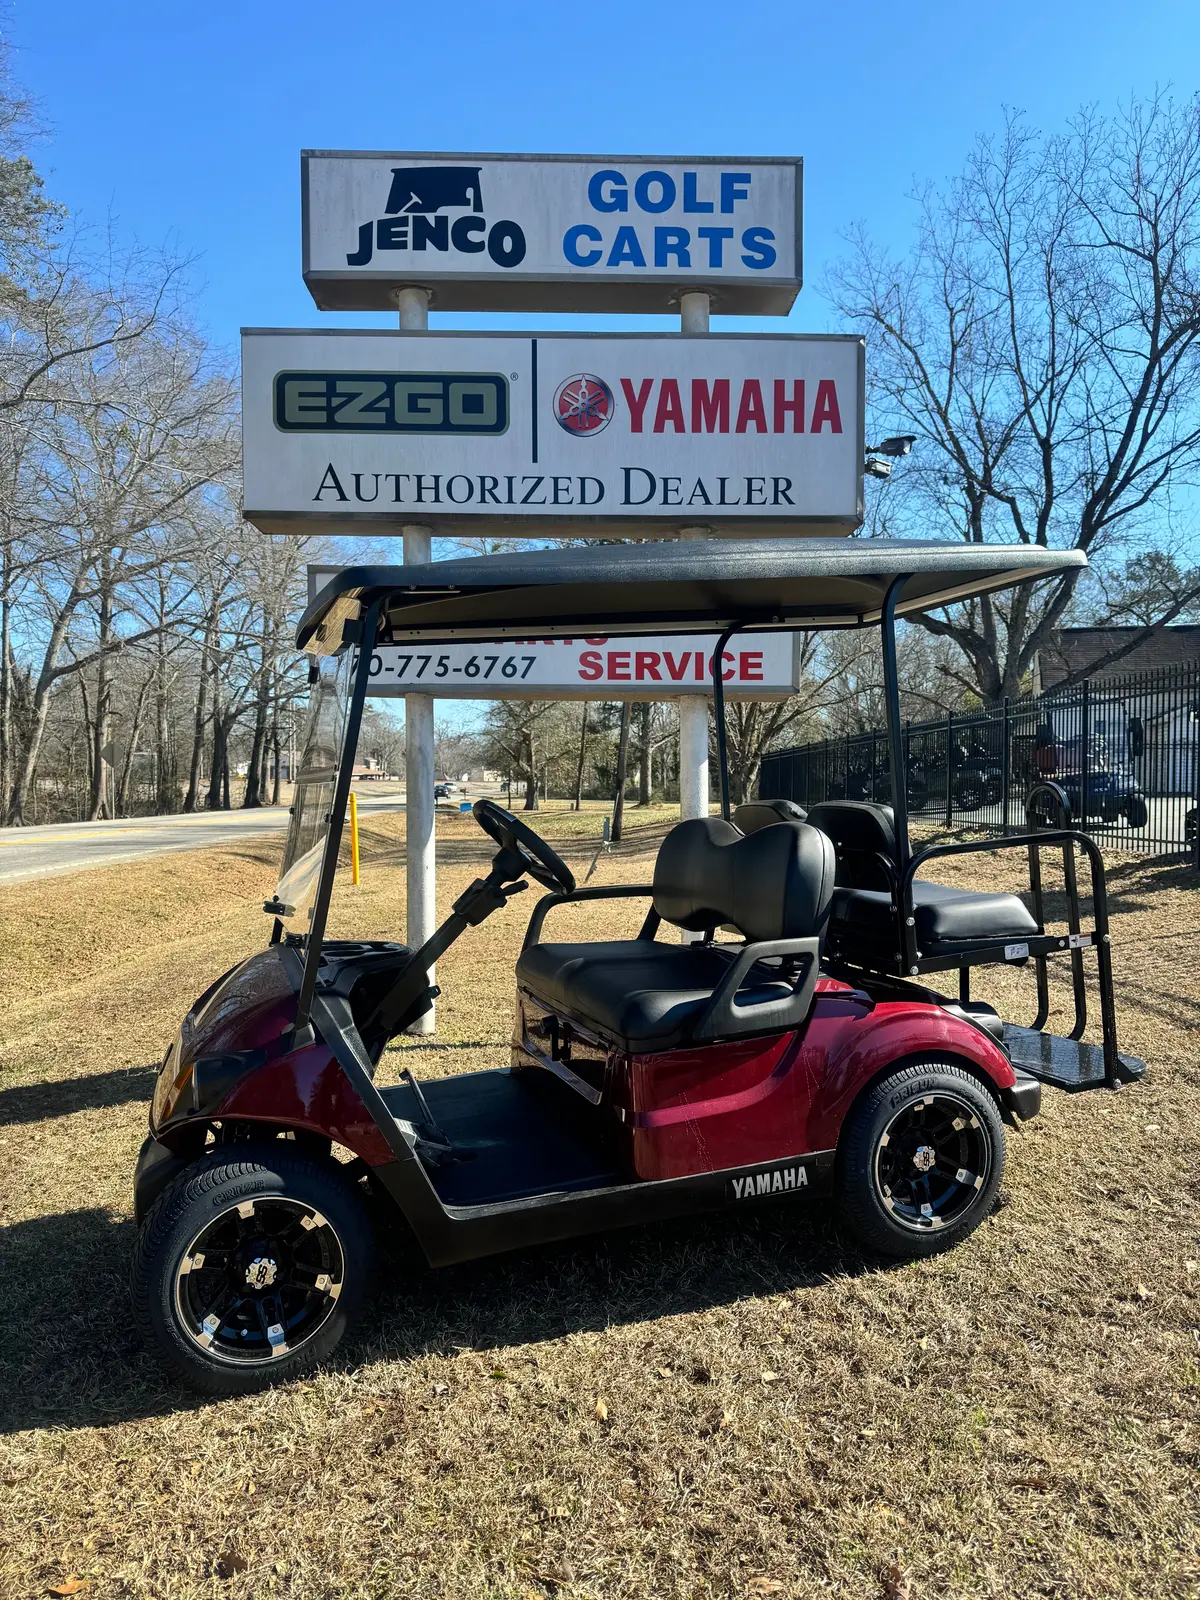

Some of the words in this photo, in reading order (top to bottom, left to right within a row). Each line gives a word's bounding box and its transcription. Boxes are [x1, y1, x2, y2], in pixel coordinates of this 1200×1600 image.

[588, 170, 752, 214] GOLF
[346, 215, 527, 268] JENCO
[562, 224, 777, 270] CARTS
[284, 380, 498, 425] EZGO
[621, 379, 843, 434] YAMAHA
[313, 463, 606, 505] AUTHORIZED
[620, 467, 796, 506] DEALER
[578, 651, 764, 681] SERVICE
[732, 1166, 809, 1199] YAMAHA
